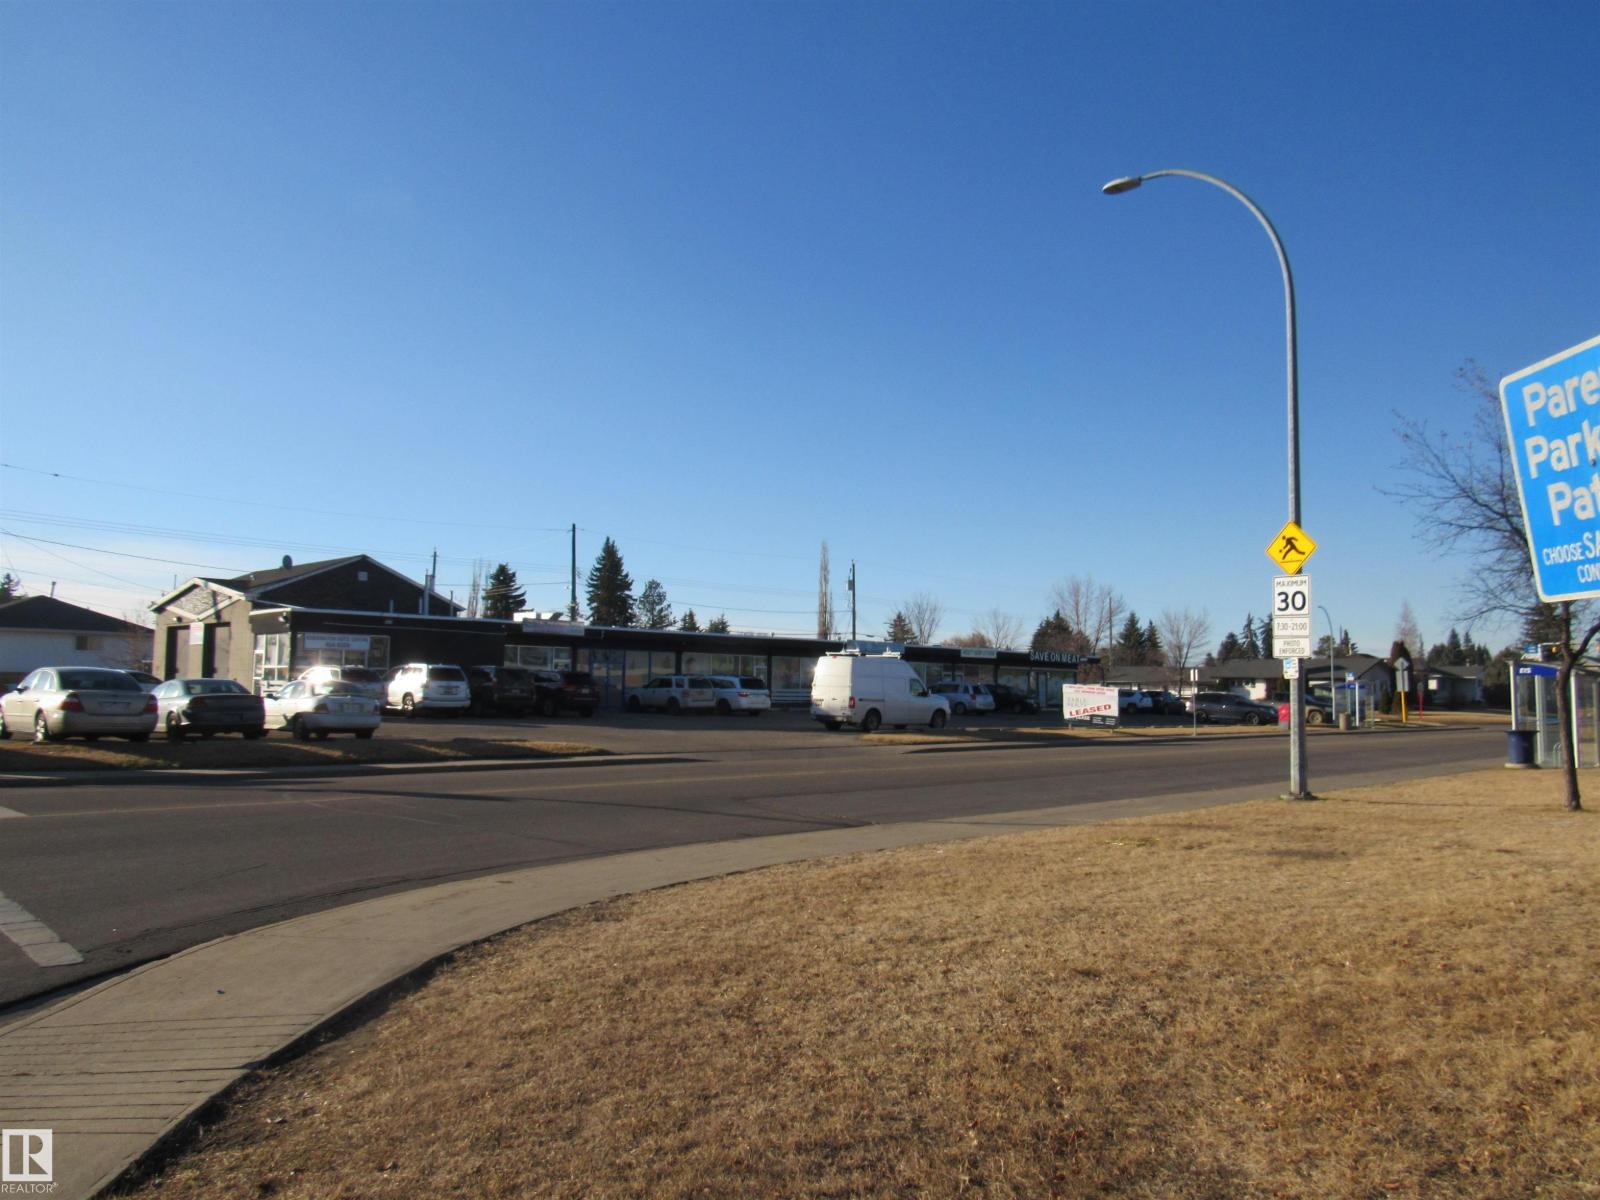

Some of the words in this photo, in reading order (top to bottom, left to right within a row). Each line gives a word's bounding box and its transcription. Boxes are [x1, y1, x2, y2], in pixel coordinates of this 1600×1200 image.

[1522, 367, 1600, 428] Pare
[1543, 542, 1585, 566] CHOOSE
[1276, 579, 1307, 588] MAXIMUM
[1277, 591, 1307, 612] 30
[1030, 650, 1049, 662] SAVE
[1050, 651, 1061, 663] ON
[1279, 647, 1305, 655] ENFORCED
[1069, 703, 1112, 717] LEASED
